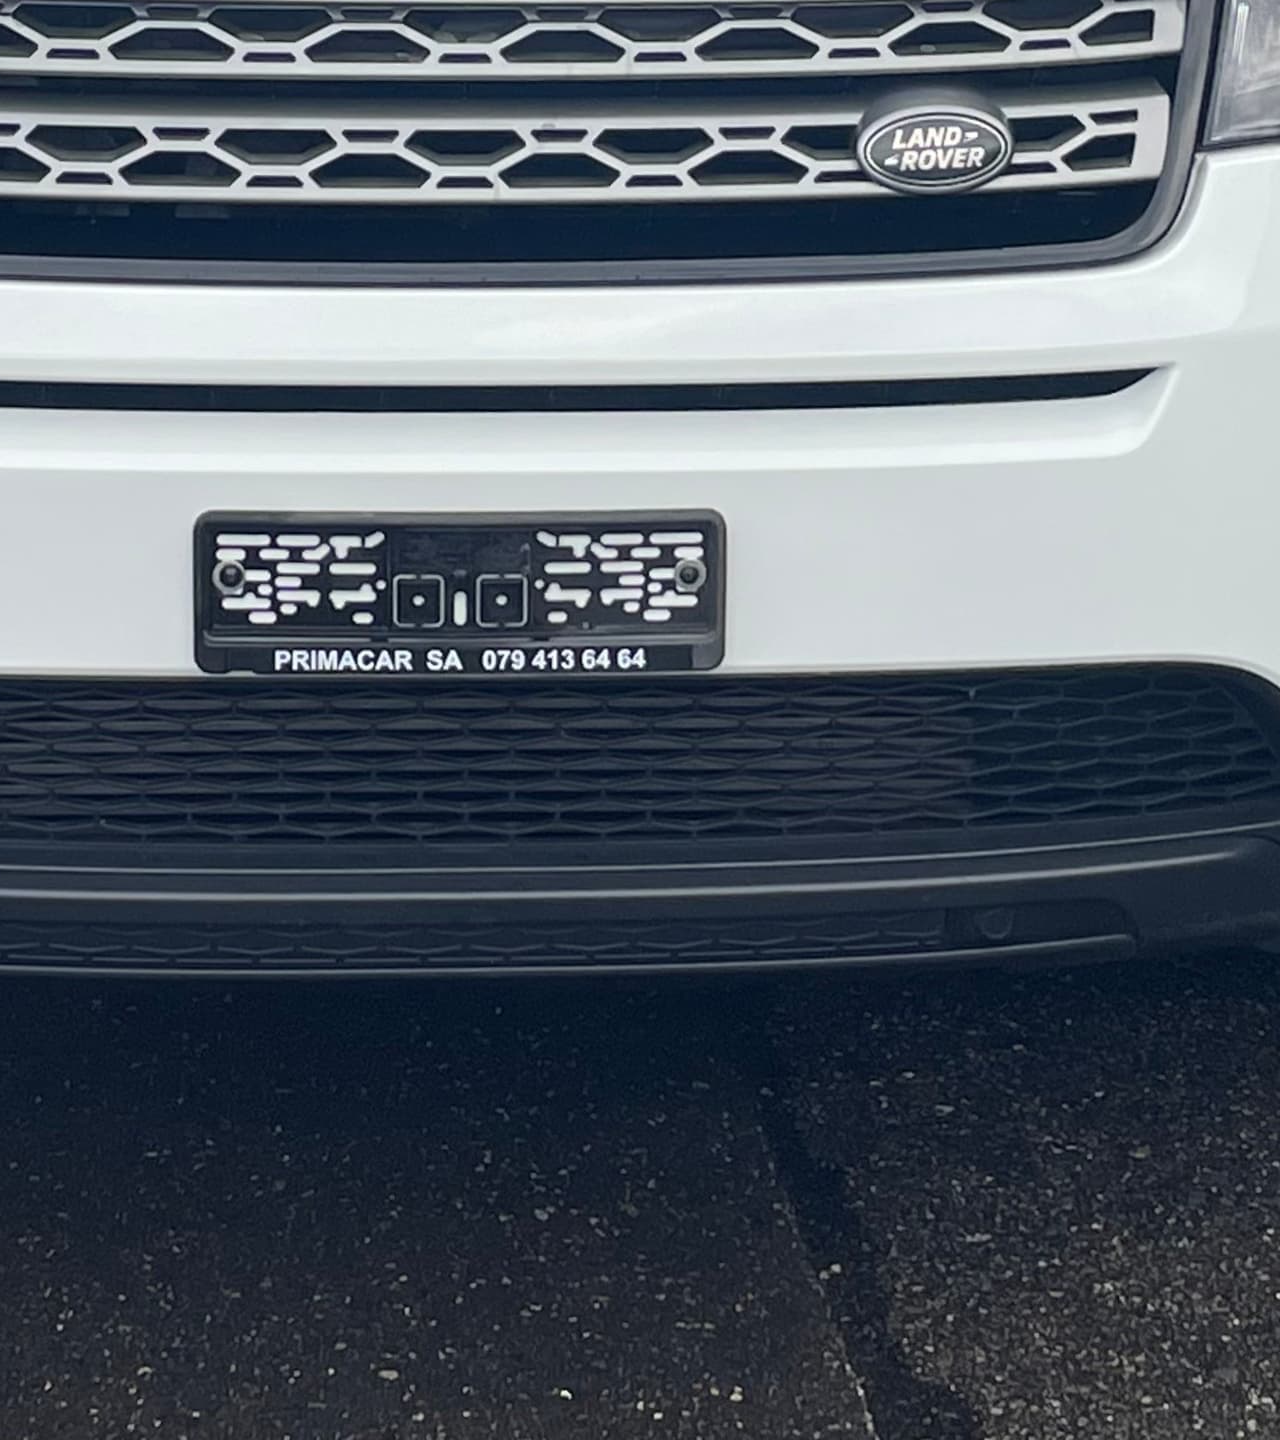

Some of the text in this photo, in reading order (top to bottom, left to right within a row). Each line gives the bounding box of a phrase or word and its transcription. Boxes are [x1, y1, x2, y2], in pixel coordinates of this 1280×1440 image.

[892, 126, 963, 150] LAND
[899, 147, 985, 172] ROVER
[274, 648, 646, 671] PRIMACAR SA 079 413 64 64
